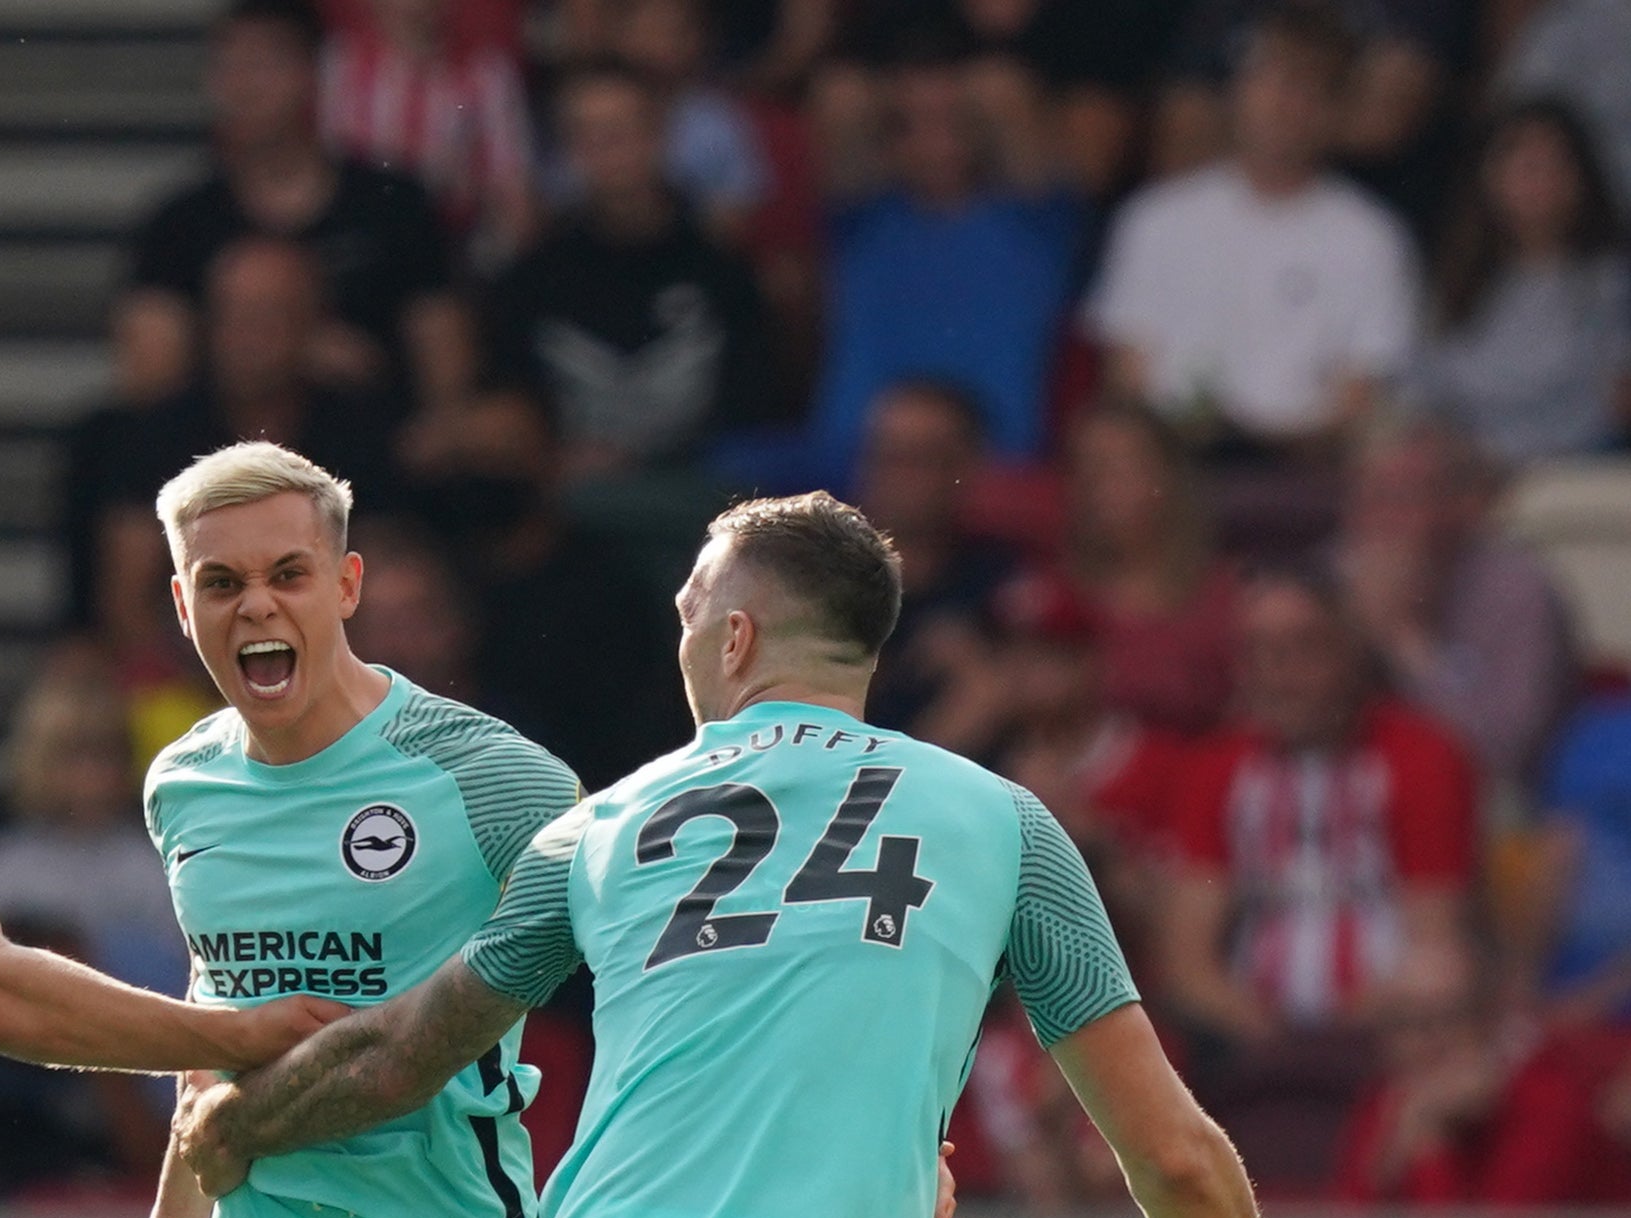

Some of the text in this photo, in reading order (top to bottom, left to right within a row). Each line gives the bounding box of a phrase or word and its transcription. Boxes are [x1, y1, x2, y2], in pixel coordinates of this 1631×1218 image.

[708, 723, 892, 765] DUFFY
[635, 765, 937, 974] 24
[188, 931, 383, 962] AMERICAN
[208, 967, 389, 998] EXPRESS
